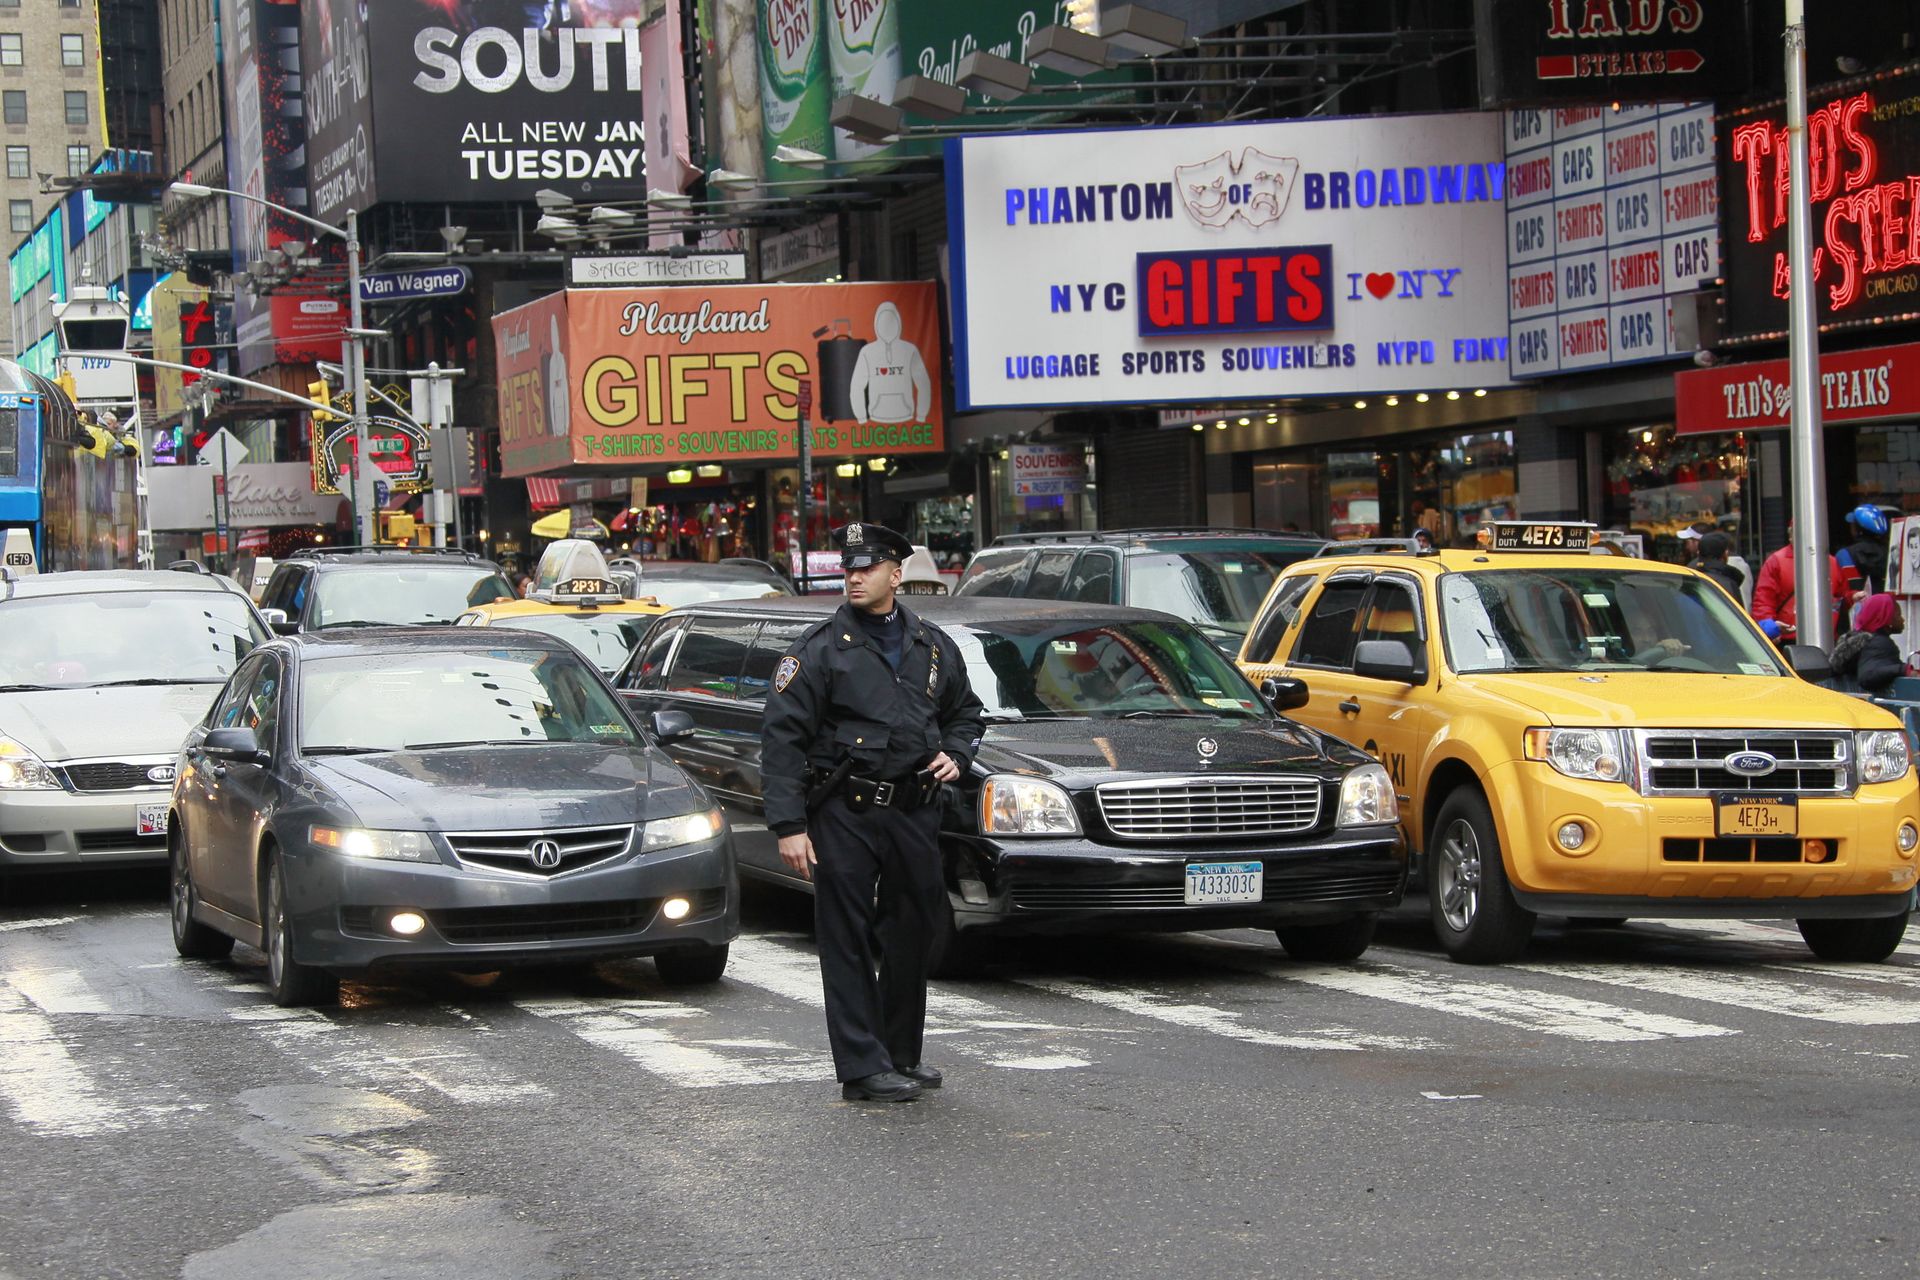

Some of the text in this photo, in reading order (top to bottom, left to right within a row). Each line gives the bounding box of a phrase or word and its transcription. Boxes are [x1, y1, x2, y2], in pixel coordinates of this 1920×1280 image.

[784, 0, 810, 60] DRY
[1579, 51, 1666, 77] STEAKS
[461, 120, 645, 144] ALL NEW JAN
[1513, 107, 1542, 141] CAPS
[1670, 118, 1705, 162] CAPS
[1507, 129, 1657, 199] T-SHIRTS CAPS T-SHIRTS
[1006, 161, 1506, 226] PHANTOM OF BROADWAY
[1515, 179, 1717, 254] CAPS T-SHIRTS CAPS T-SHIRTS
[364, 273, 460, 295] Van Wagner
[588, 259, 730, 280] SAGE THEATER
[1511, 236, 1709, 310] T-SHIRTS CAPS T-SHIRTS CAPS
[1051, 282, 1126, 313] NYC
[1147, 252, 1324, 329] GIFTS
[1396, 266, 1463, 300] NY
[619, 299, 771, 345] Playland
[502, 313, 531, 363] Playland
[1518, 328, 1549, 365] CAPS
[1560, 317, 1608, 358] T-SHIRTS
[1620, 311, 1654, 350] CAPS
[81, 357, 111, 370] NYPD
[1005, 353, 1101, 380] LUGGAGE
[1121, 348, 1206, 375] SPORTS
[1377, 338, 1436, 366] NYPD
[1453, 335, 1509, 364] FDNY
[582, 350, 811, 427] GIFTS
[1723, 374, 1774, 419] TAD'S
[1822, 365, 1891, 410] TEAKS
[501, 367, 545, 443] GIFTS
[585, 434, 665, 457] T-SHIRTS
[678, 429, 779, 455] SOUVENIRS
[850, 422, 935, 448] LUGGAGE
[1016, 453, 1081, 469] SOUVENIRS
[1498, 538, 1518, 547] DUTY
[1502, 527, 1516, 536] OFF
[1522, 526, 1564, 546] 4E73
[1567, 538, 1586, 548] DUTY
[1570, 528, 1584, 537] OFF
[8, 554, 30, 565] 1E79
[571, 580, 600, 593] 2P31
[1382, 751, 1406, 788] AXI
[1740, 757, 1764, 769] Ford
[1739, 797, 1778, 805] NEW YORK
[1657, 816, 1713, 824] ESCAPE
[1738, 807, 1778, 827] 4E73H
[1205, 865, 1244, 874] NEW YORK
